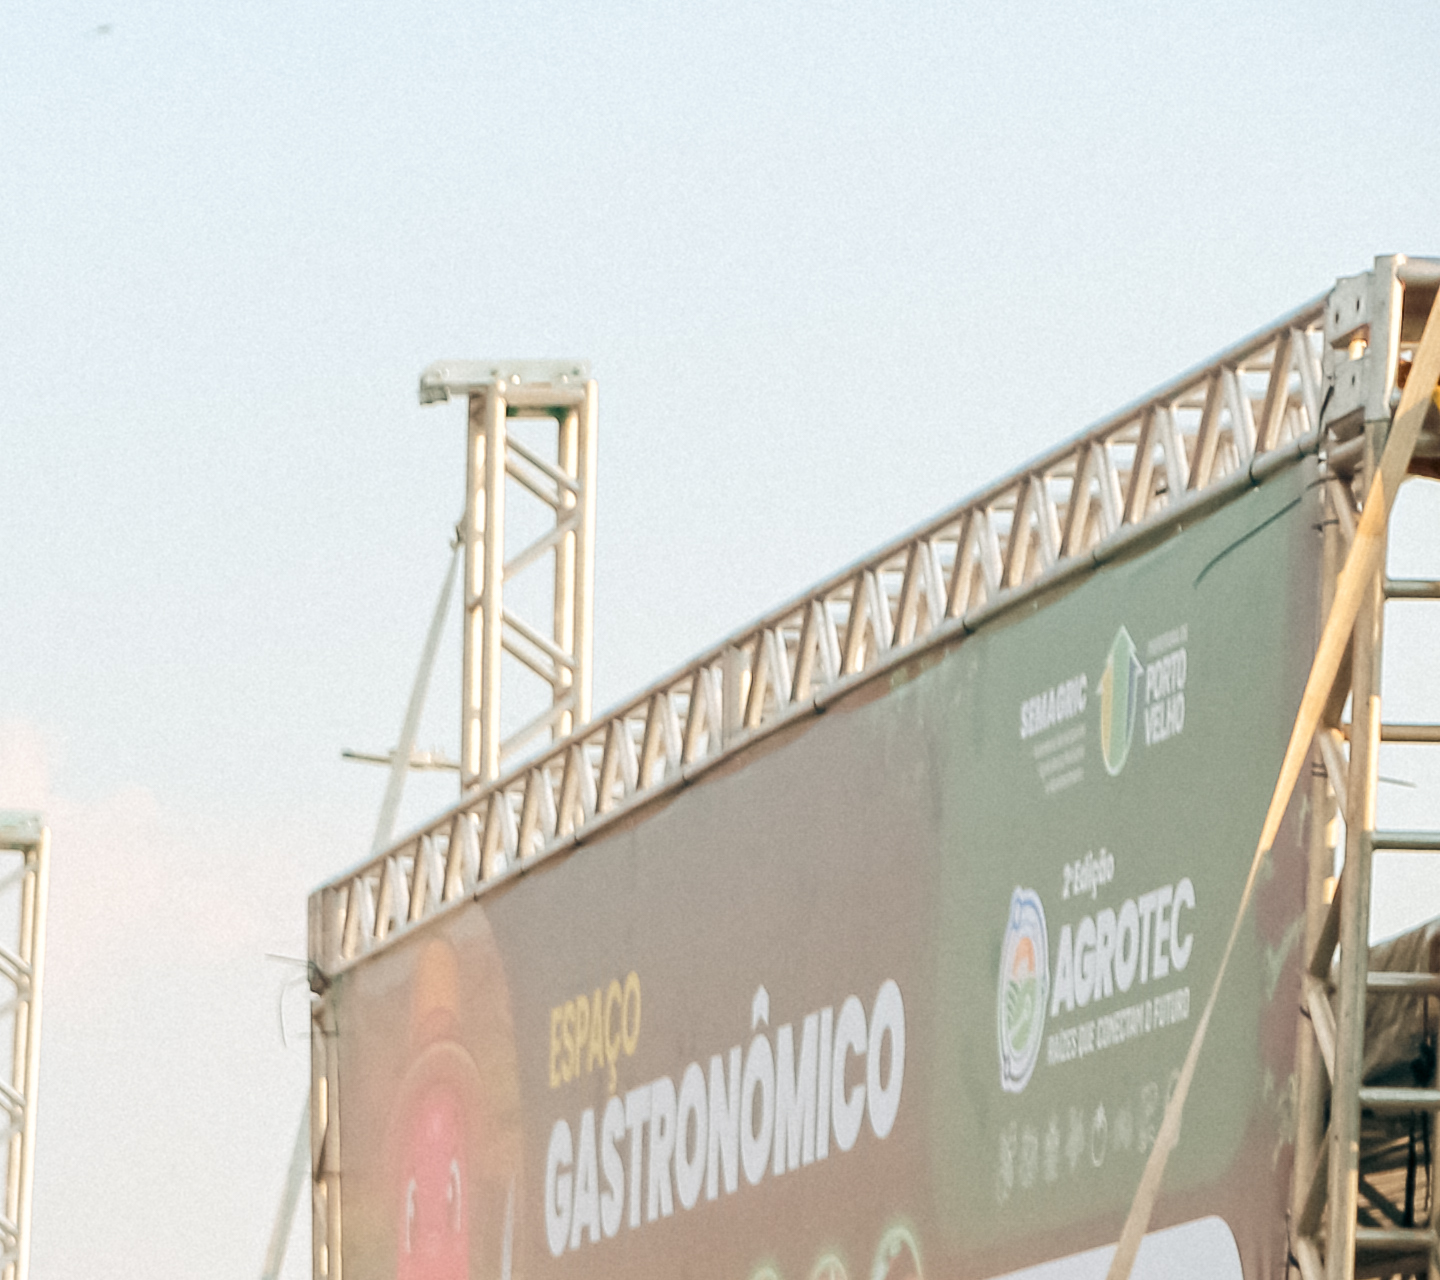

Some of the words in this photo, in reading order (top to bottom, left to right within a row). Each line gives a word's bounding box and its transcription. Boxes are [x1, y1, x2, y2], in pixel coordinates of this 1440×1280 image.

[1145, 691, 1186, 746] VELHO
[1146, 647, 1188, 704] PORTO
[1051, 877, 1193, 1017] AGROTEC
[550, 970, 642, 1094] ESPAÇO
[545, 978, 906, 1257] GASTRONÔMICO
